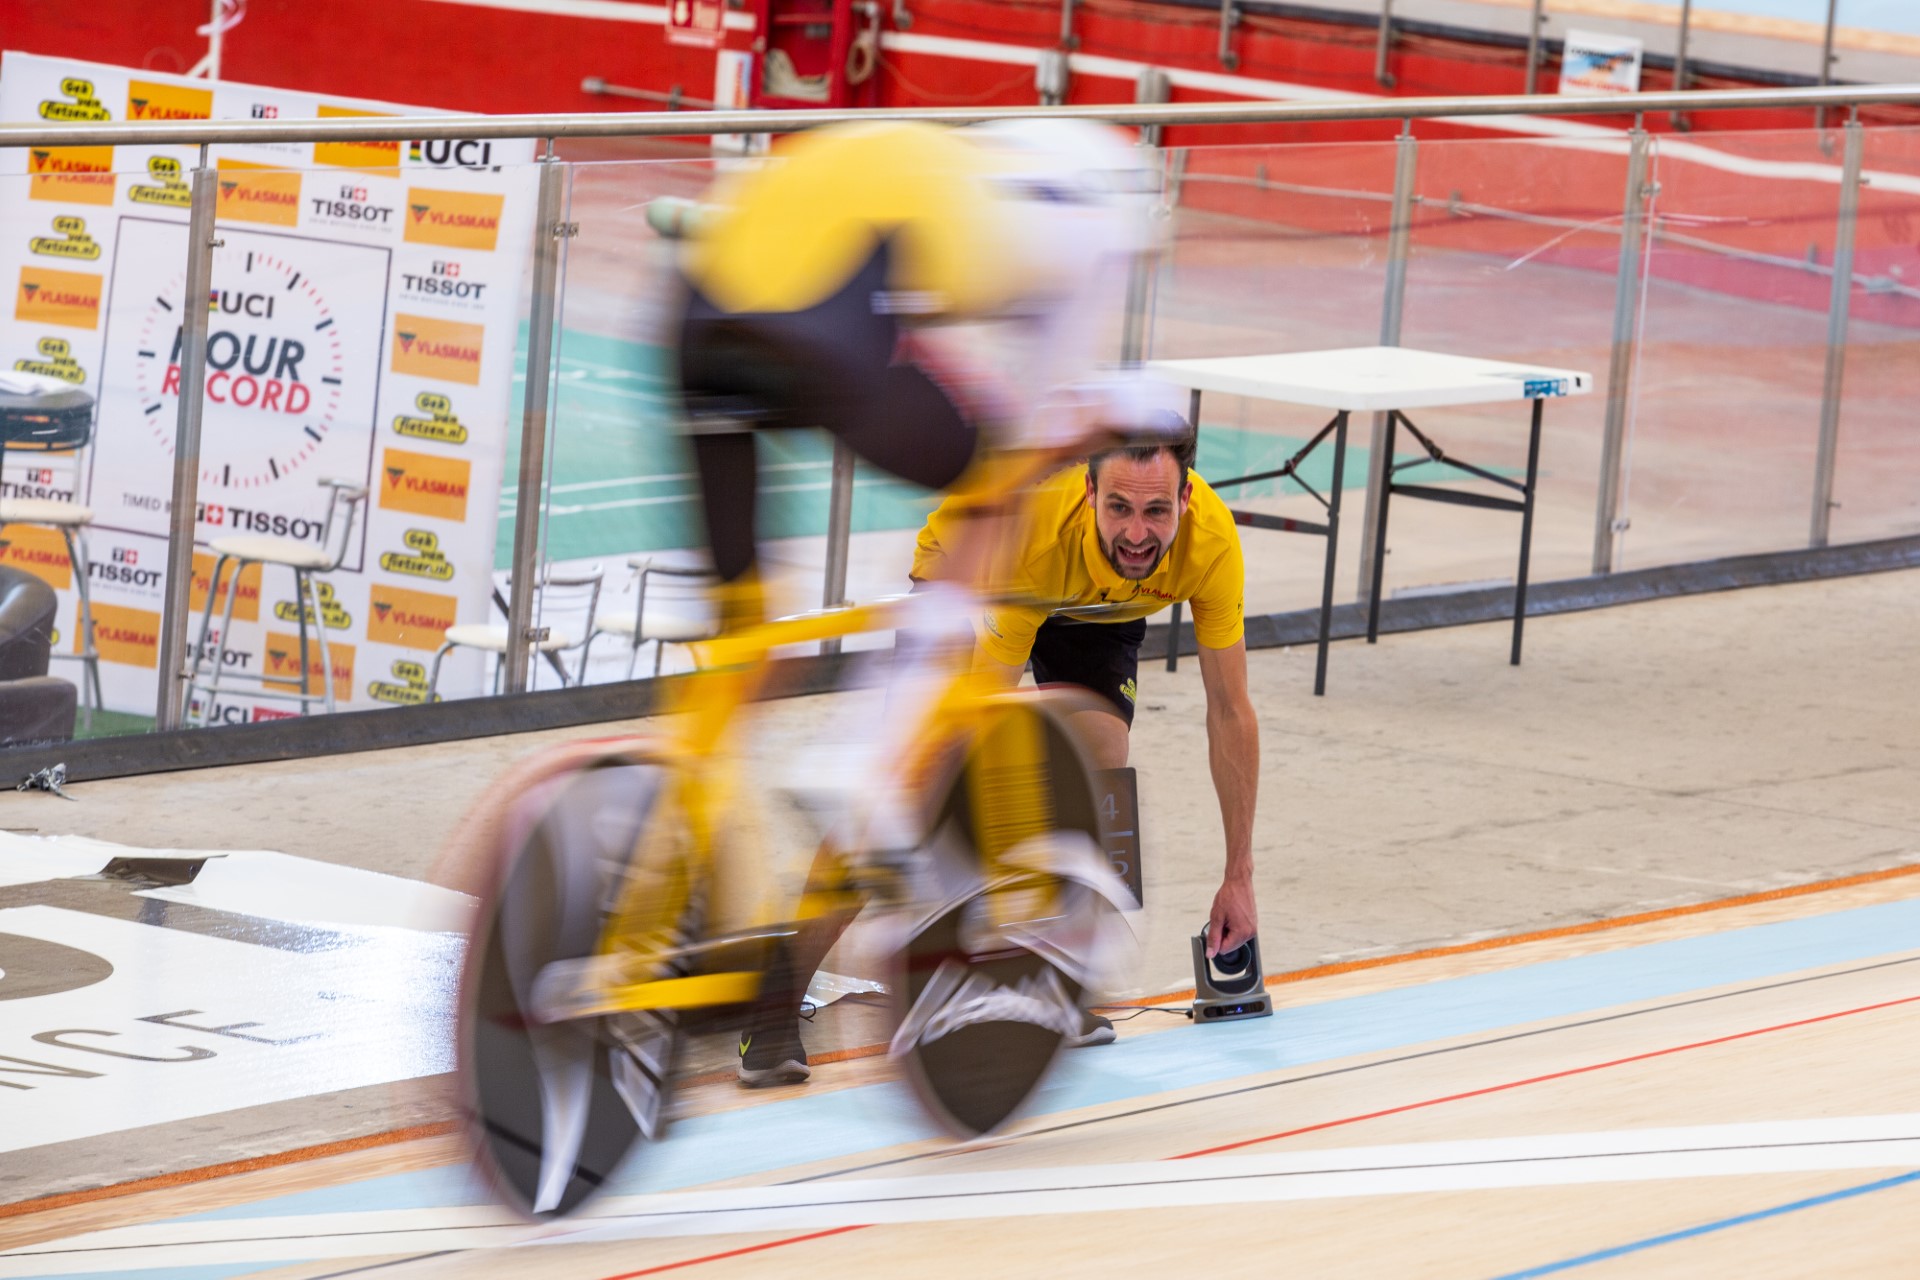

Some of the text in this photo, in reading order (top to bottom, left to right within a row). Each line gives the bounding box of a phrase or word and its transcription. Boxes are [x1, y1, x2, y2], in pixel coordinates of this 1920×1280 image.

[237, 187, 297, 206] VLASMAN
[312, 198, 393, 223] TISSOT
[430, 211, 497, 229] VLASMAN
[402, 274, 487, 300] TISSOT
[221, 291, 274, 318] UCI
[416, 340, 480, 363] VLASMAN
[161, 364, 310, 414] RCORD
[405, 477, 466, 498] VLASMAN
[122, 492, 161, 511] TIMED
[228, 507, 324, 543] TISSOT
[87, 561, 162, 588] TISSOT
